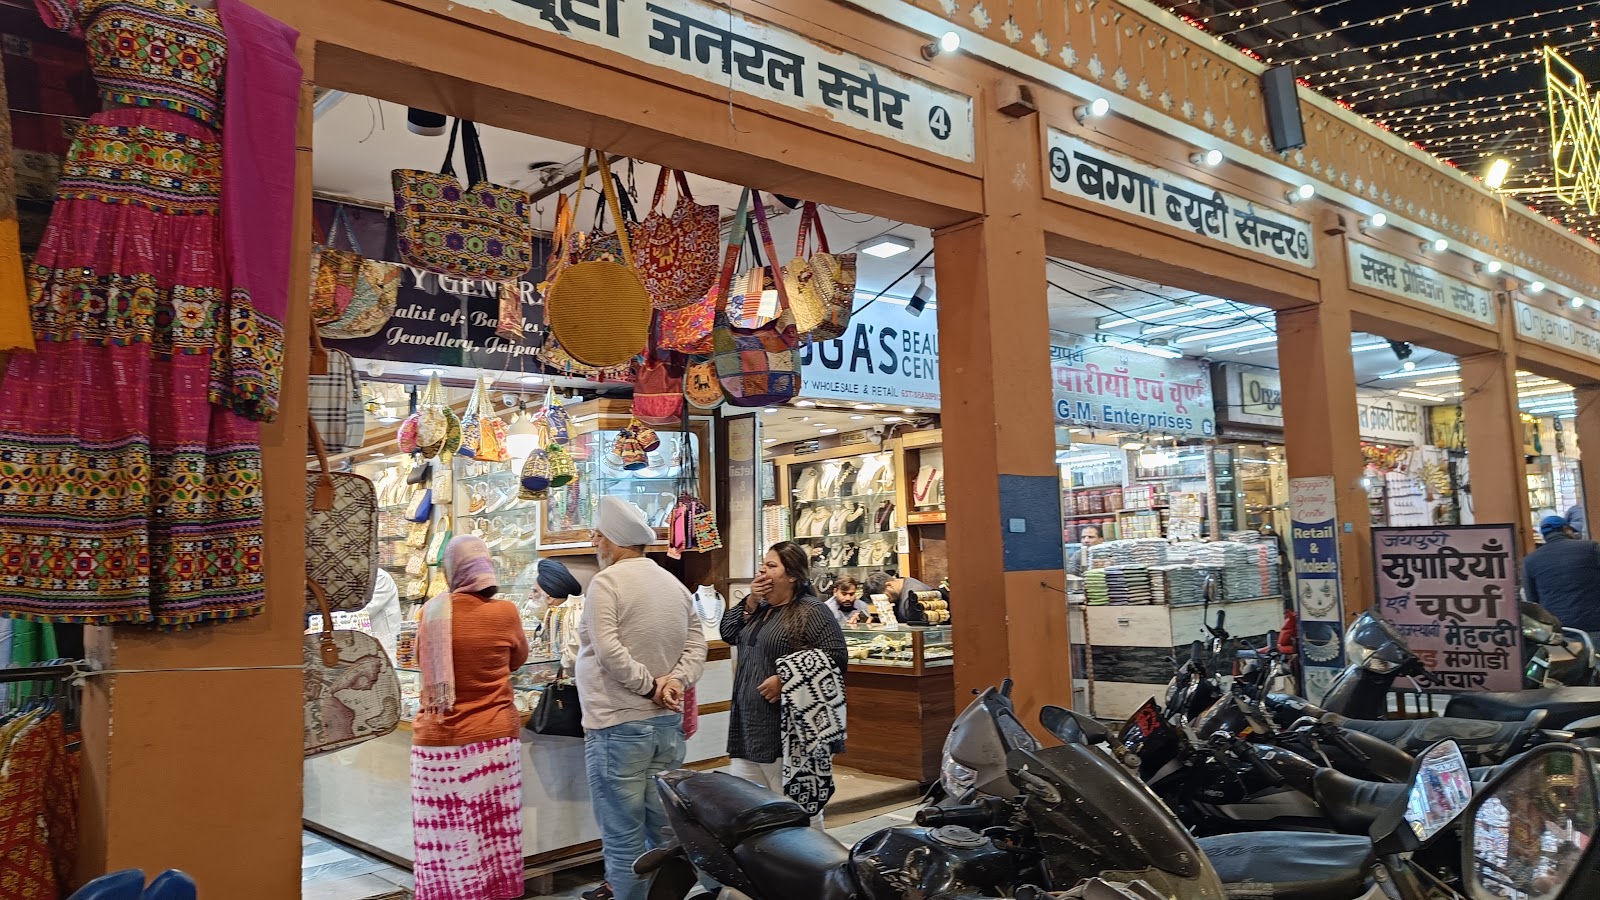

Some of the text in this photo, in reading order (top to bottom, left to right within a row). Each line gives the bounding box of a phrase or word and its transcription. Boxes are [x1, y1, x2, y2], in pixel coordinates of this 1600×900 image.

[646, 4, 804, 98] जनरल
[817, 62, 910, 130] स्टोर
[929, 106, 950, 138] 4
[1051, 149, 1069, 179] 5
[1073, 150, 1159, 215] बग्गा
[1162, 183, 1229, 238] ब्यूटी
[1297, 232, 1309, 259] 5
[1449, 285, 1476, 313] स्टोर
[439, 309, 466, 327] of:
[470, 311, 544, 336] Bales,
[386, 327, 480, 353] Jewellery,
[902, 355, 939, 380] CEN
[812, 380, 859, 394] WHOLESALE
[863, 385, 870, 396] &
[872, 386, 898, 398] RETAIL
[1133, 373, 1165, 403] एवं
[1169, 379, 1204, 414] चूर्ण
[1057, 399, 1097, 421] G.M.
[1103, 405, 1193, 430] Enterprises
[1294, 526, 1333, 539] Retail
[1382, 531, 1450, 549] जयपुरी
[1309, 542, 1319, 554] &
[1295, 558, 1336, 573] Wholesale
[1381, 538, 1508, 588] सुपारियाँ
[1384, 584, 1502, 622] एवं चूर्ण
[1444, 619, 1517, 648] मेहन्दी
